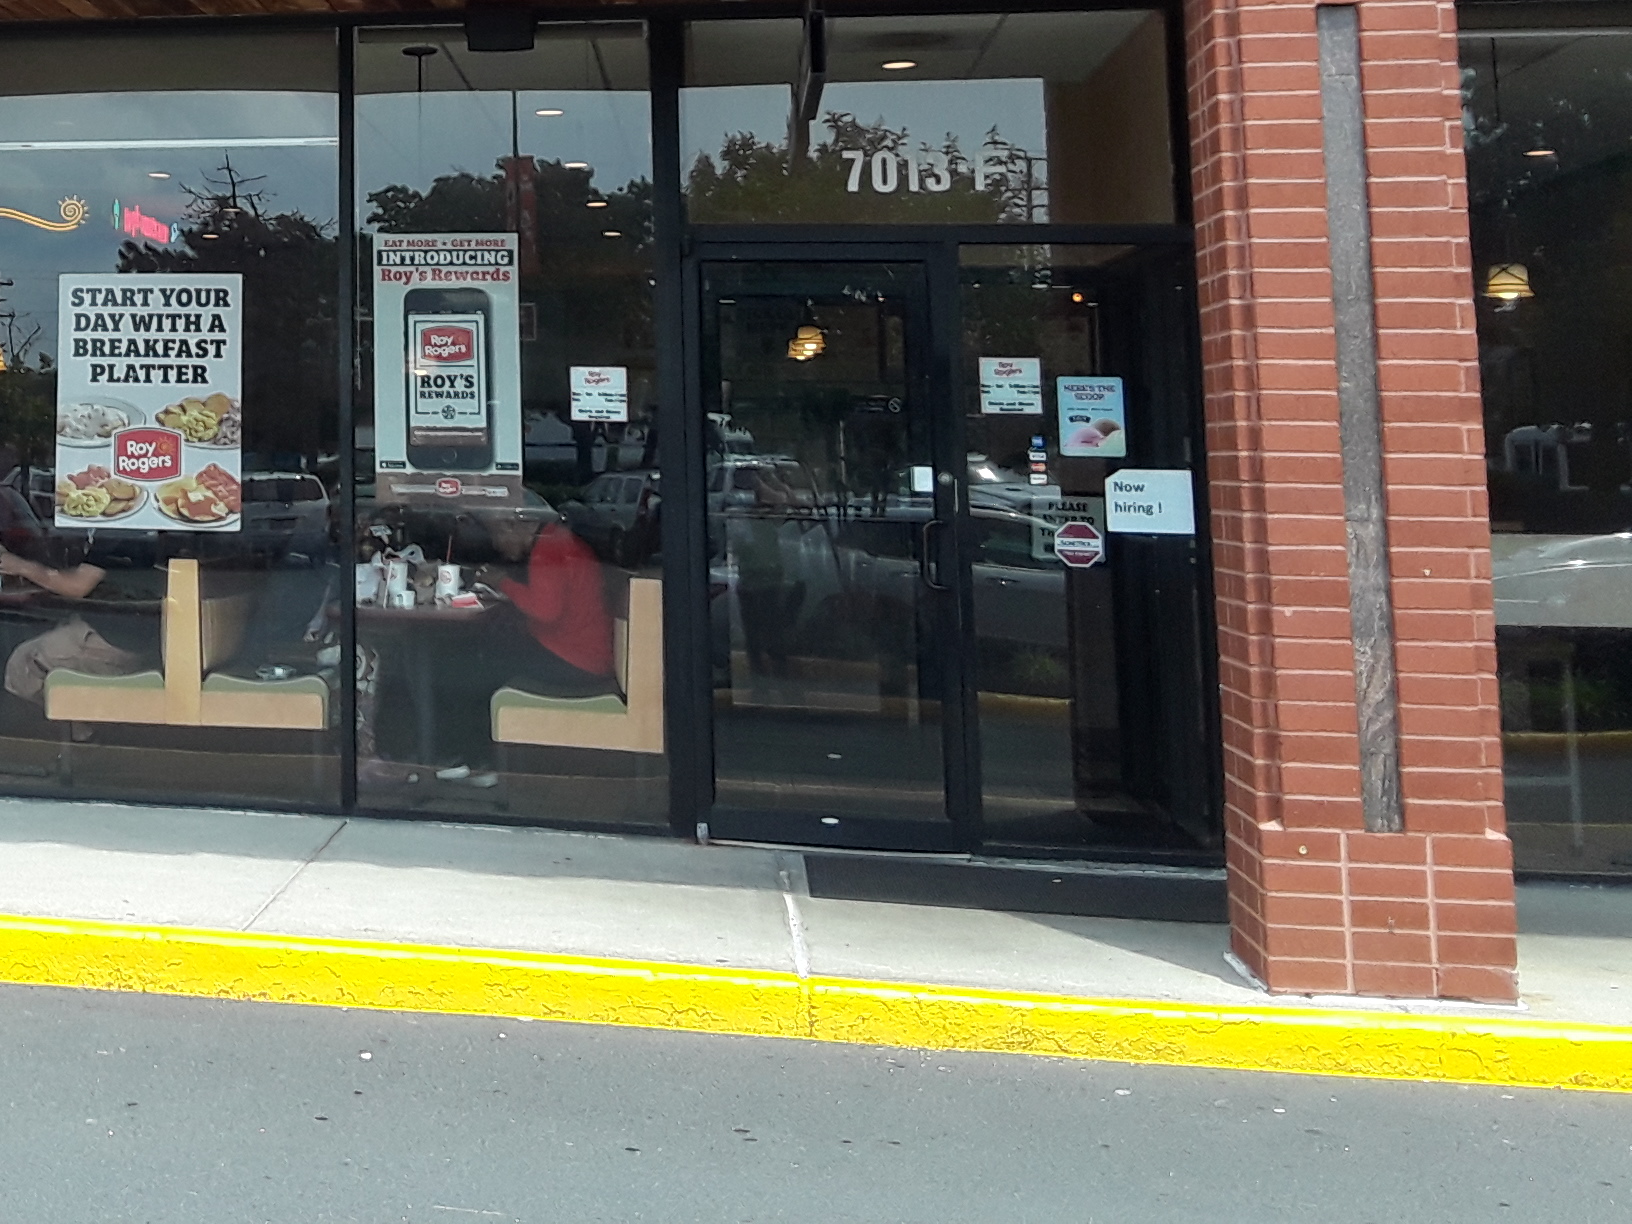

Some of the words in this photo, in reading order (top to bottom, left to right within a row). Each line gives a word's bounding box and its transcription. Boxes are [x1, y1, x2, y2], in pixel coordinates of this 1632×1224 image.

[384, 239, 404, 247] EAT
[406, 239, 438, 247] MORE
[451, 239, 472, 247] GET
[475, 239, 506, 247] MORE
[381, 250, 509, 265] INTRODUCING
[380, 267, 428, 285] Roy's
[431, 267, 511, 282] Rewards
[70, 287, 154, 307] START
[159, 287, 231, 308] YOUR
[73, 313, 125, 332] DAY
[129, 313, 202, 333] WITH
[207, 313, 227, 333] A
[430, 334, 453, 345] Roy
[72, 338, 227, 358] BREAKFAST
[89, 363, 209, 384] PLATTER
[420, 373, 474, 389] ROY'S
[419, 390, 476, 399] REWARDS
[126, 440, 156, 457] Roy
[118, 455, 172, 473] Rogers
[1113, 481, 1145, 492] Now
[1114, 501, 1153, 515] hiring
